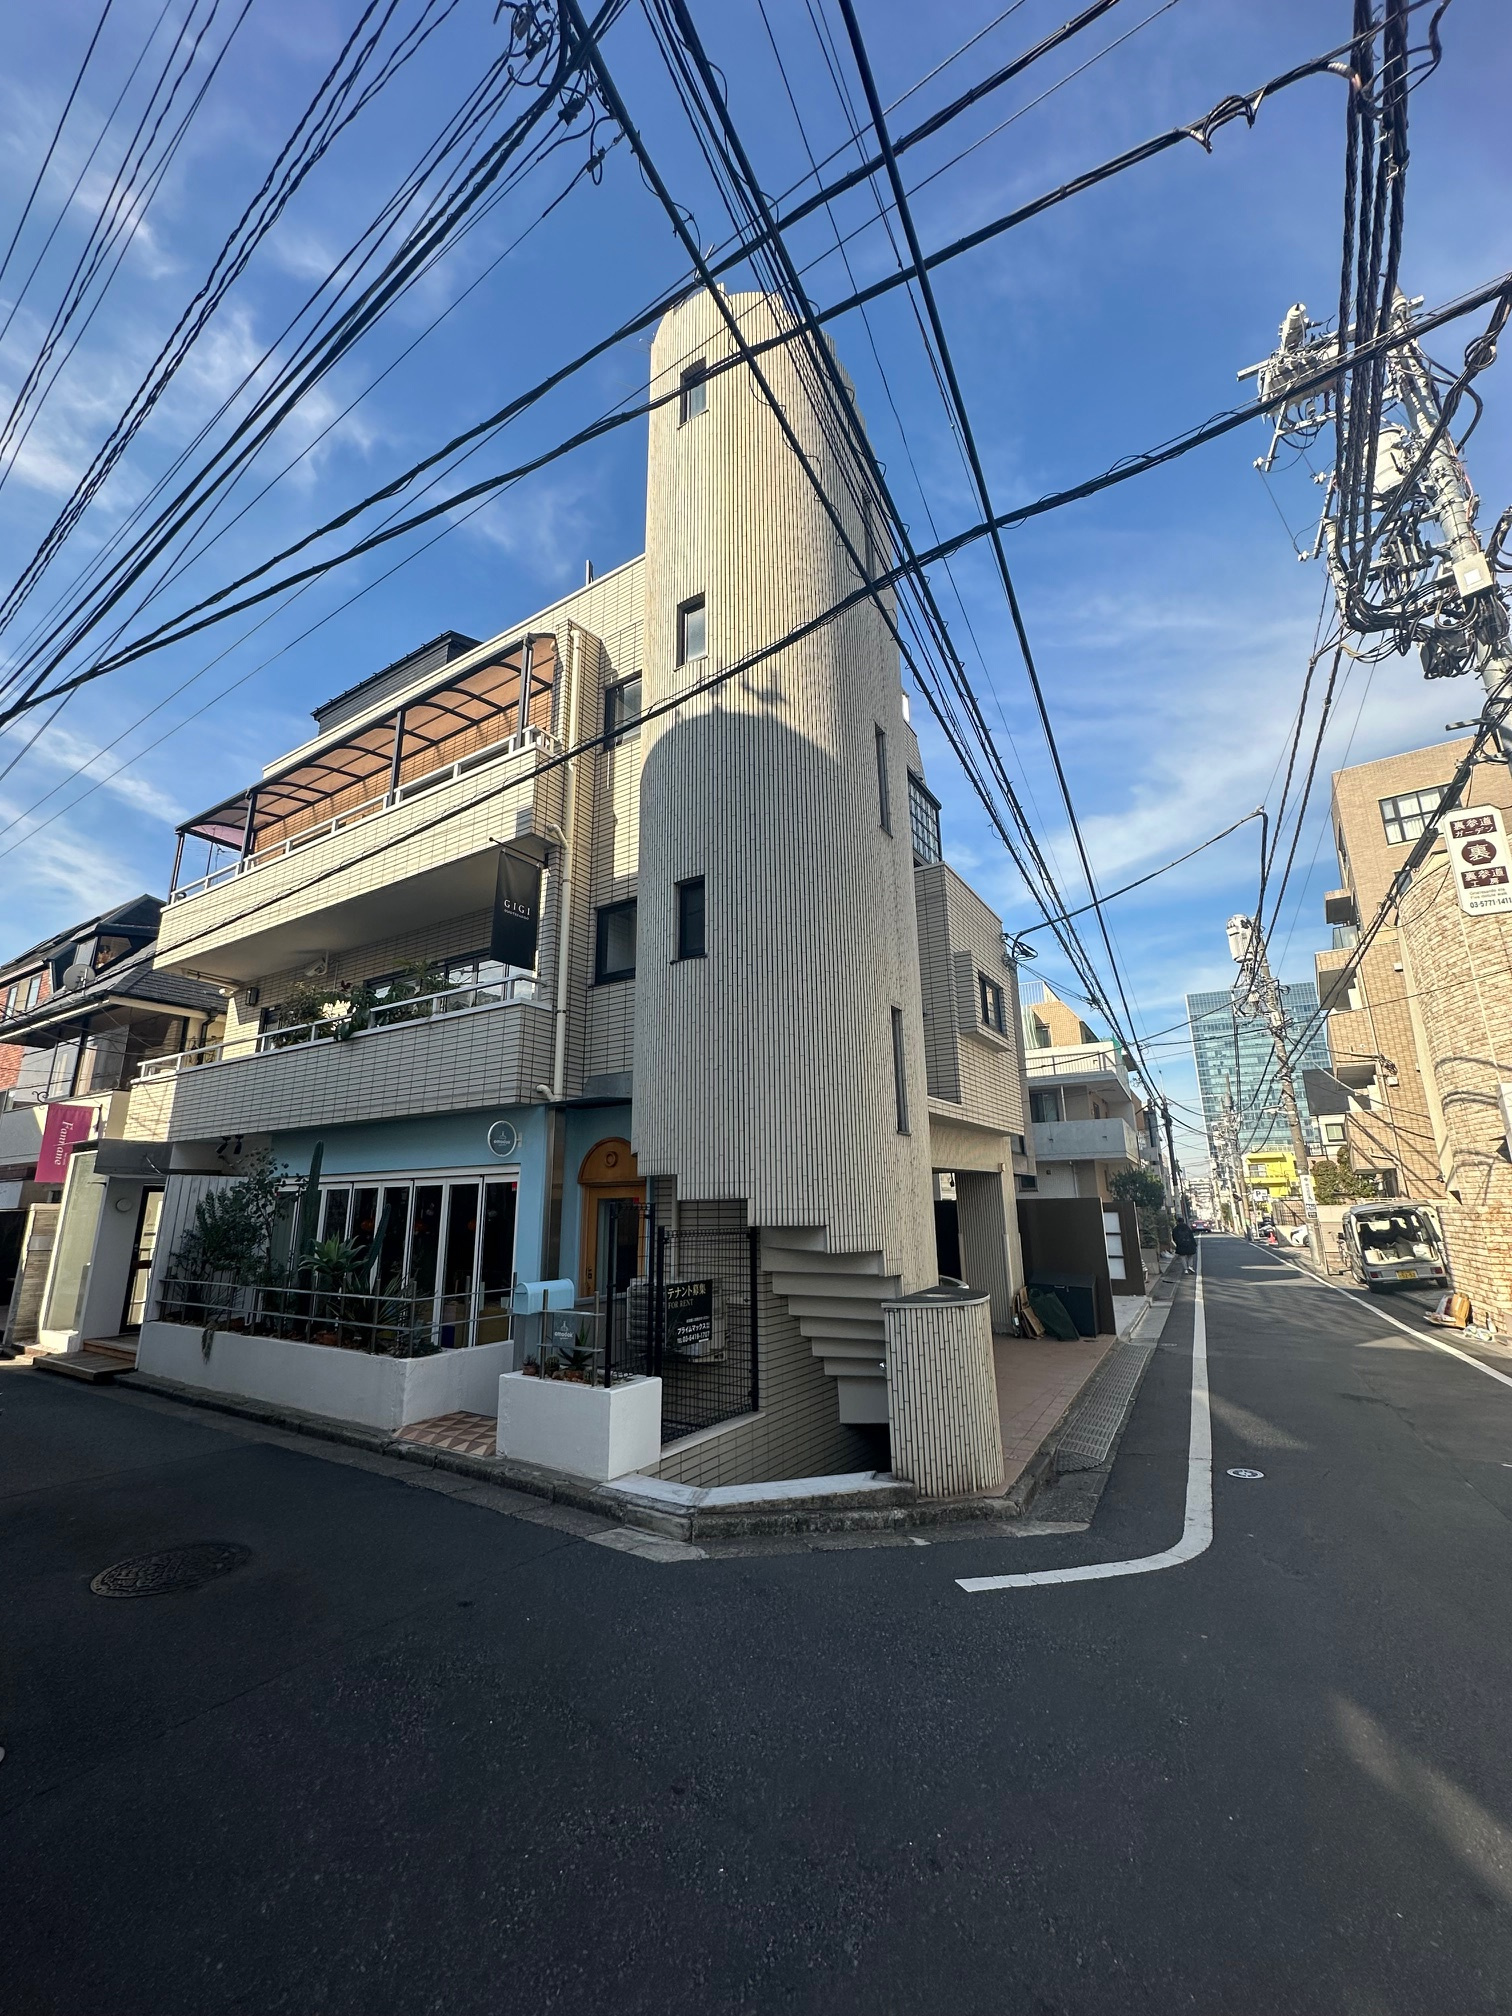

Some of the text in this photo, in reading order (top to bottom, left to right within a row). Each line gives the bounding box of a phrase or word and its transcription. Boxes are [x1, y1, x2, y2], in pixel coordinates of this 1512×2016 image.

[1453, 816, 1493, 831] 裏参道
[1455, 826, 1494, 838] ガーデン
[1467, 843, 1491, 861] 裏
[1465, 867, 1505, 881] 裏参道
[503, 899, 531, 916] GIGI
[667, 1283, 706, 1300] テナント募集
[667, 1299, 694, 1310] FOR RENT
